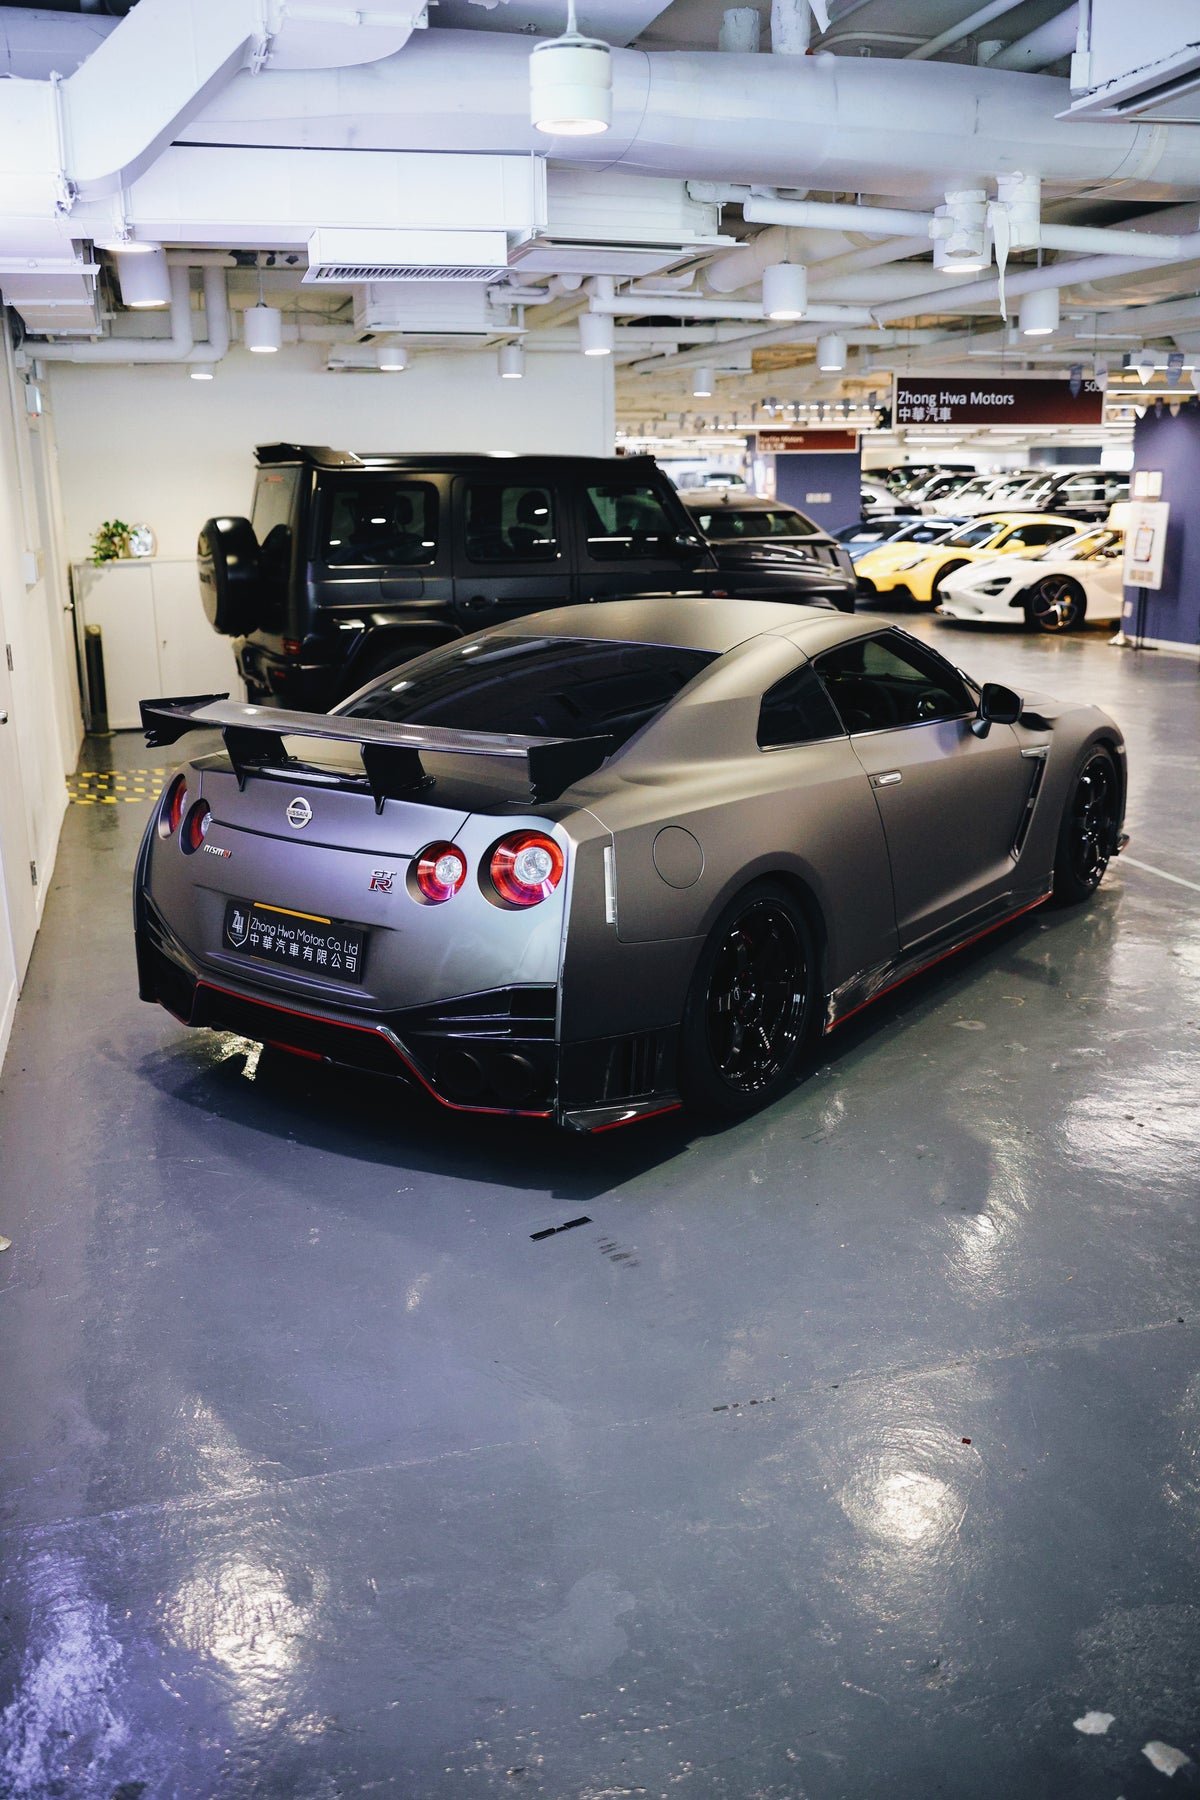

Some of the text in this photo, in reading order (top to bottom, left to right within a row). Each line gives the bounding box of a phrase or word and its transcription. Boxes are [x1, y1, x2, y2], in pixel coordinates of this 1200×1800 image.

[897, 391, 1015, 406] Zhong Hwa Motors
[898, 407, 952, 422] 中華汽車
[287, 808, 309, 818] NISSAN
[250, 917, 276, 936] Zhong
[277, 924, 295, 940] Hwa
[296, 928, 325, 947] Motors
[326, 936, 342, 951] Co.
[343, 940, 358, 955] Ltd
[249, 932, 357, 973] 中華汽車有限公司
